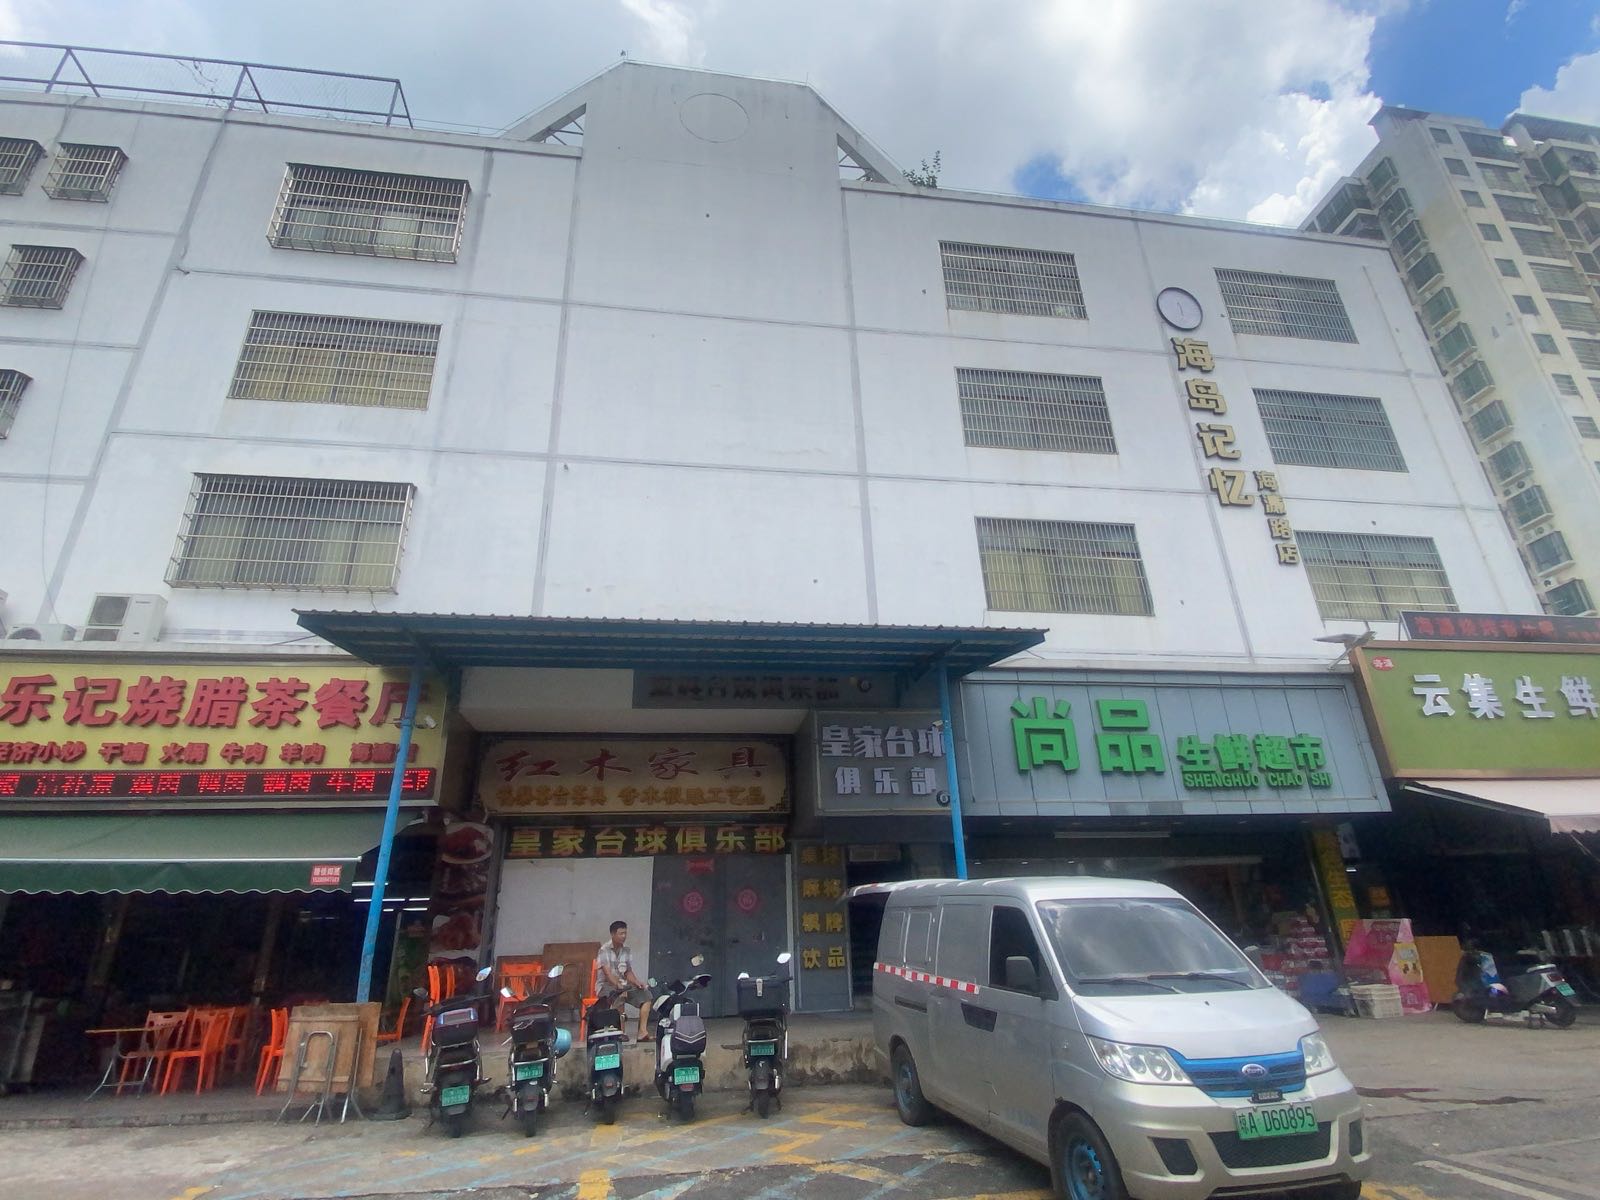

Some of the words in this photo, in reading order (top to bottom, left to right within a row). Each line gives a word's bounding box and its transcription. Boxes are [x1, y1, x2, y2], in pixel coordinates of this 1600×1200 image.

[1171, 337, 1254, 508] 海岛记忆
[1412, 673, 1600, 720] 云集生鲜
[821, 725, 946, 758] 皇家台球
[1012, 697, 1166, 773] 尚品
[220, 742, 268, 765] 牛肉
[279, 742, 327, 765] 羊肉
[1177, 733, 1327, 772] 生鲜超市
[834, 766, 938, 796] 俱乐部
[1184, 771, 1260, 790] SHENGHUO
[1267, 771, 1304, 788] CHAO
[1311, 771, 1333, 788] SHI
[510, 826, 787, 856] 皇家台球俱乐部
[802, 945, 847, 969] 饮品
[1261, 1105, 1315, 1132] D60895
